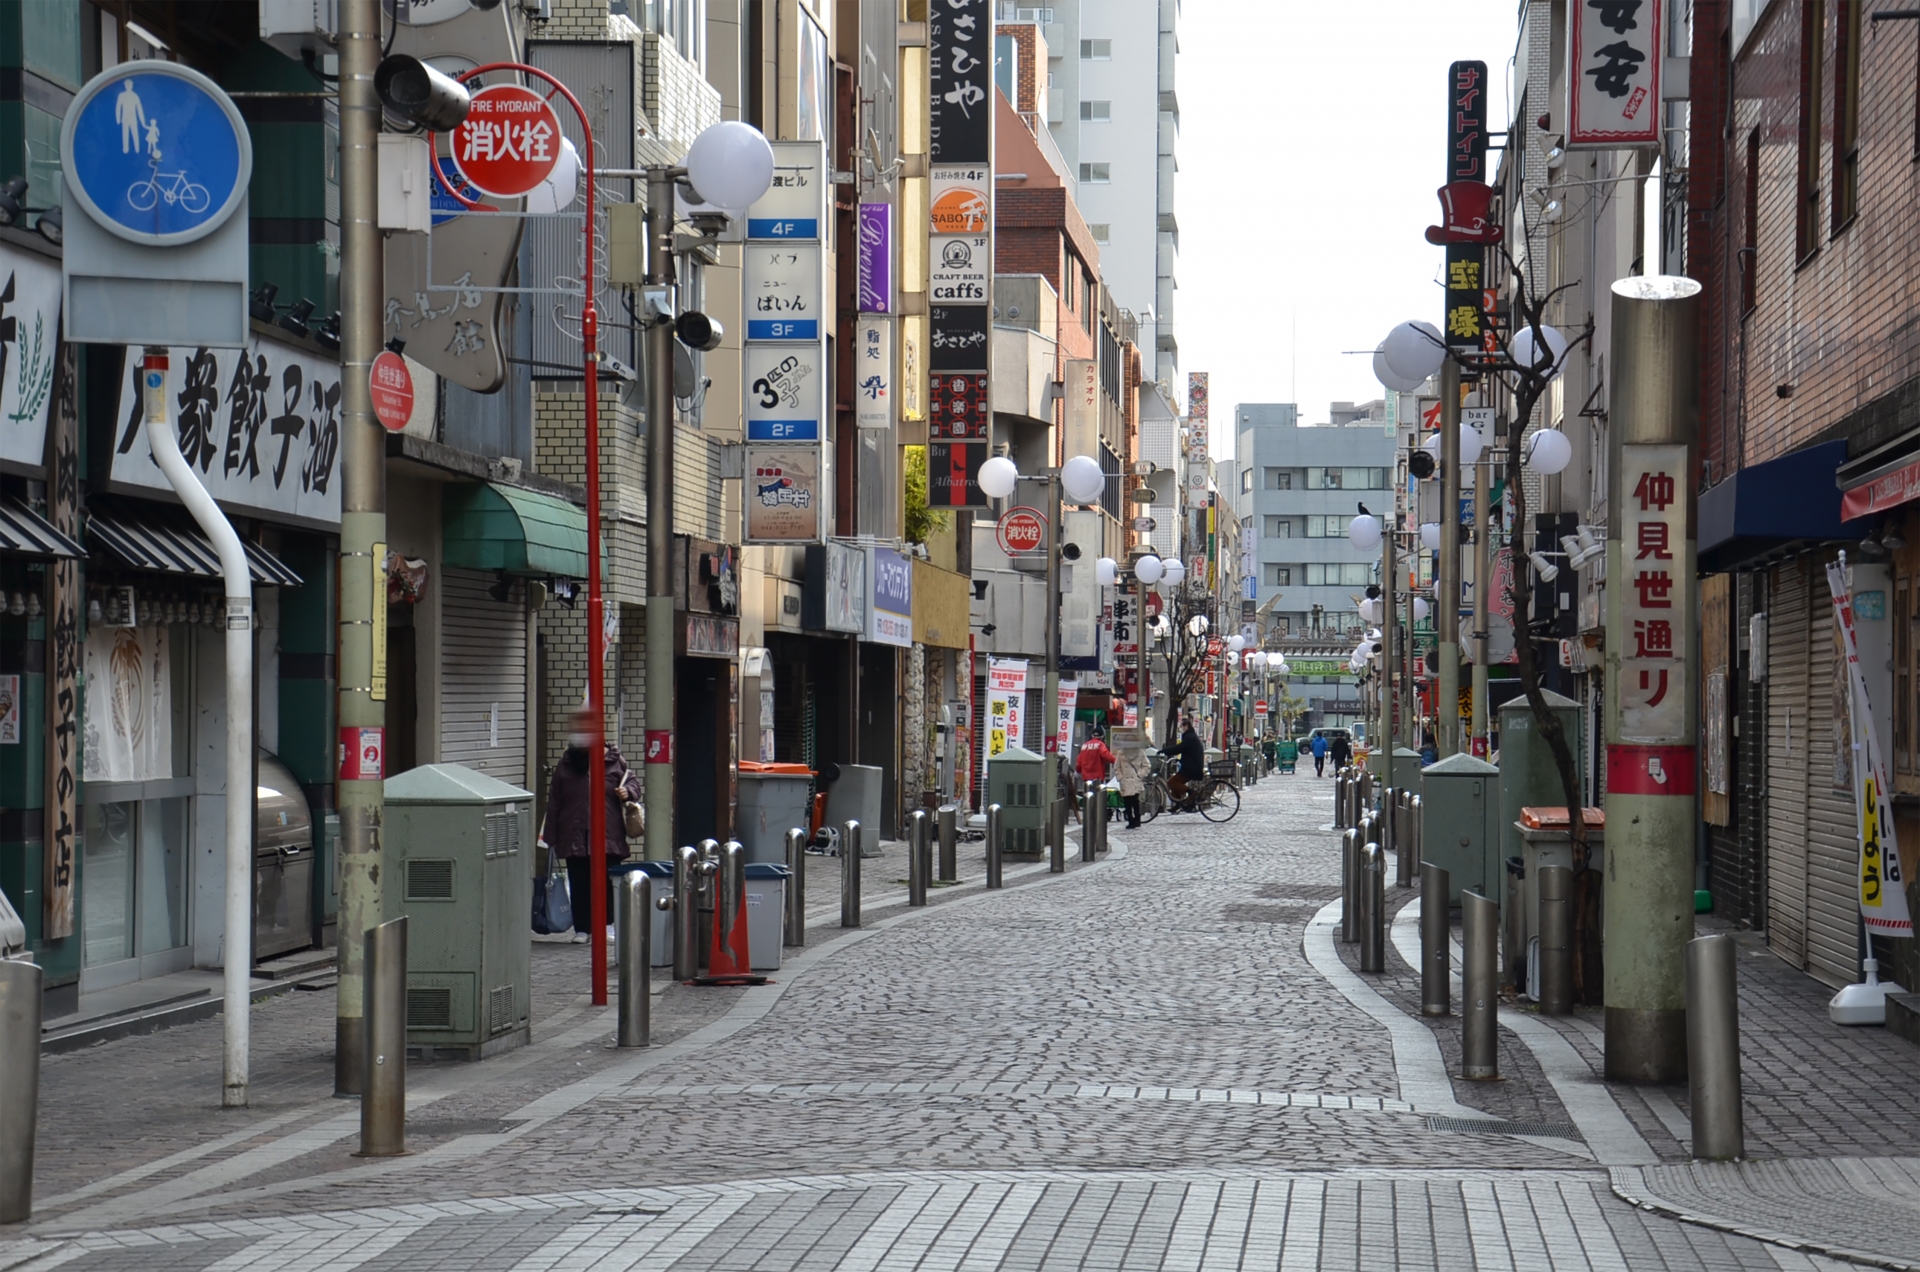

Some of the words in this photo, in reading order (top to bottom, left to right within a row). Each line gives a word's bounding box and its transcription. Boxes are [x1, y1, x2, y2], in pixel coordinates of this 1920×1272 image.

[931, 8, 941, 81] ASAHI
[945, 0, 984, 119] さひや
[471, 101, 493, 112] FIRE
[496, 101, 543, 112] HYDRANT
[931, 93, 941, 156] BLDG
[462, 119, 552, 161] 消火栓
[934, 171, 966, 180] お好み焼き
[967, 171, 984, 181] 4F
[931, 213, 988, 223] SABOTEN
[771, 222, 794, 235] 4F
[861, 213, 885, 307] Brenda
[934, 283, 983, 298] caffs
[1449, 259, 1480, 338] 宝塚
[757, 295, 807, 311] ぱいん
[933, 308, 948, 319] 2F
[771, 323, 794, 336] 3F
[932, 328, 986, 348] あさひや
[866, 329, 880, 360] 鮨処
[753, 356, 798, 409] 3匹の
[1086, 365, 1095, 406] カラオケ
[1468, 410, 1488, 419] bar
[772, 424, 794, 436] 2F
[761, 487, 810, 508] 韓国村
[1007, 525, 1039, 540] 消火栓
[1633, 471, 1675, 708] 仲見世通り
[1120, 644, 1133, 652] 2F
